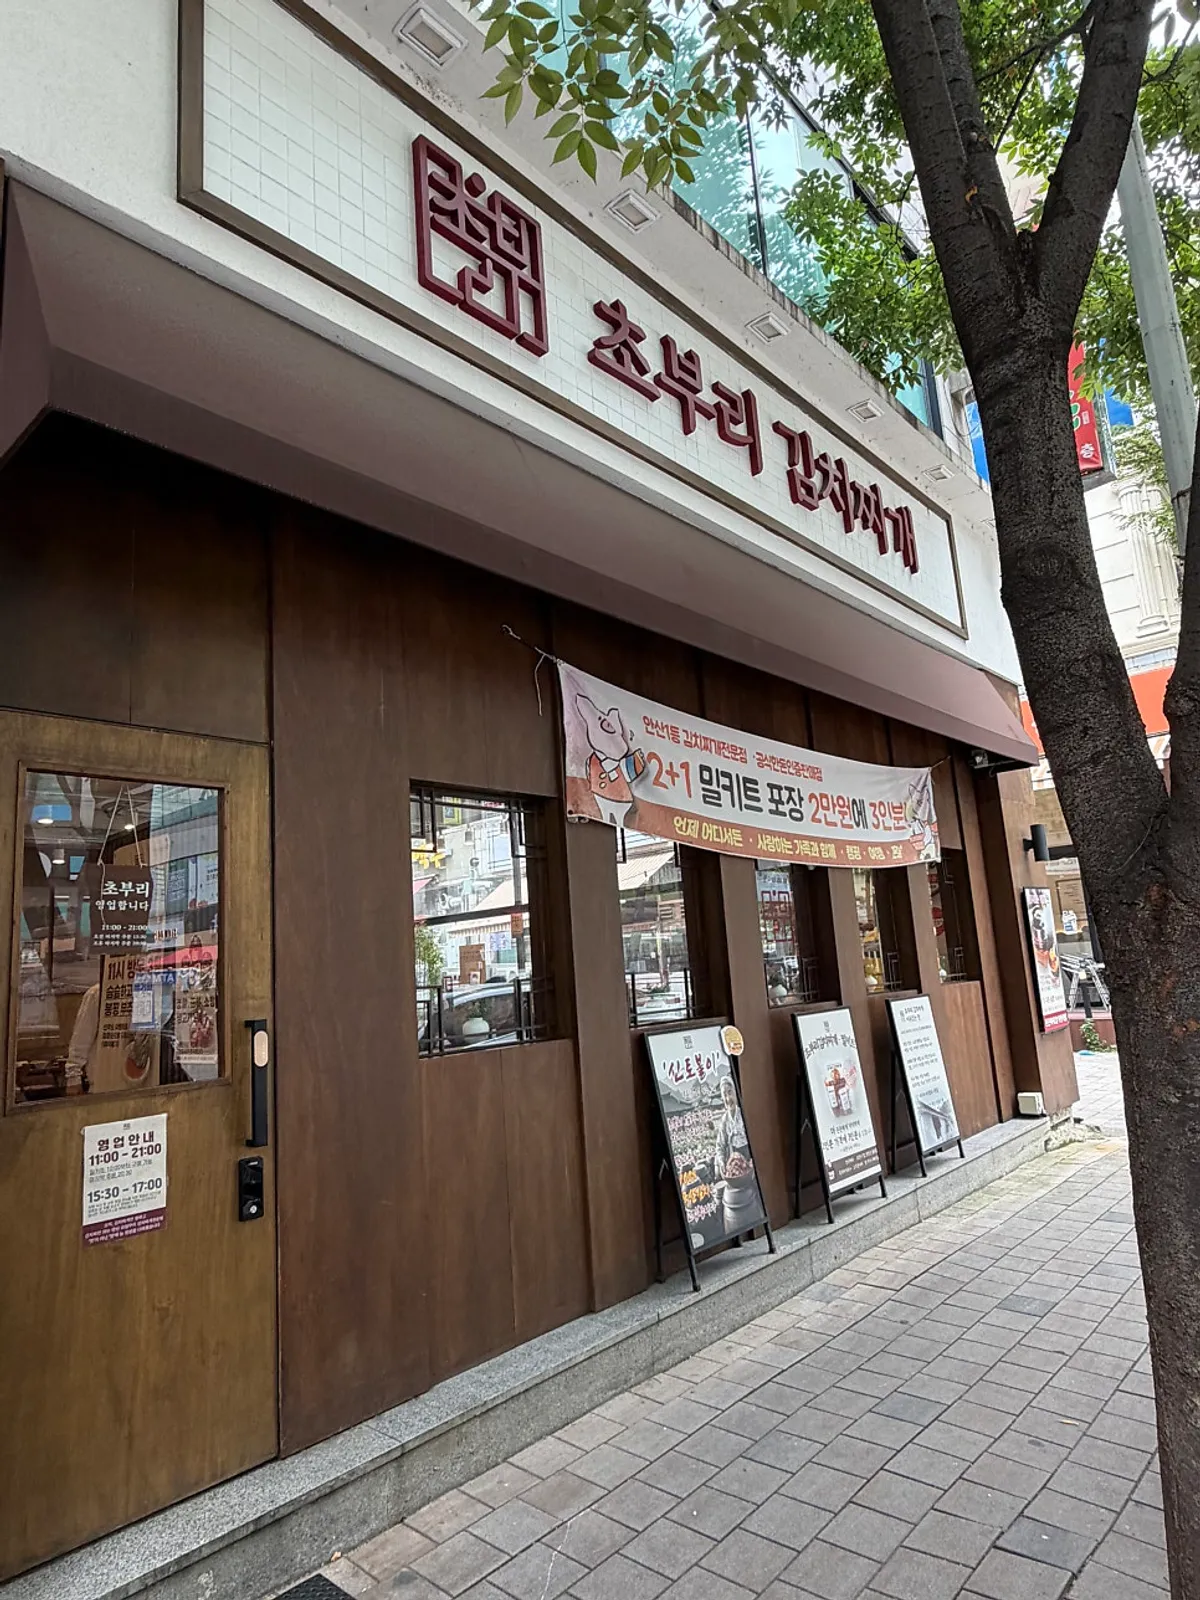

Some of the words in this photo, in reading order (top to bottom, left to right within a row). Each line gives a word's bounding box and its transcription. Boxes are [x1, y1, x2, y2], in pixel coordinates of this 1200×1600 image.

[587, 299, 762, 476] 초부리
[772, 420, 919, 574] 김치찌개
[642, 715, 681, 744] 안산1등
[682, 728, 748, 764] 김치찌개전문점
[646, 751, 693, 798] 2+1
[699, 764, 764, 816] 밀키트
[767, 783, 804, 822] 포장
[807, 794, 869, 830] 2만원에
[673, 816, 700, 838] 언제
[701, 822, 744, 847] 어디서든
[757, 833, 793, 855] 사랑하는
[794, 839, 820, 857] 가족과
[102, 880, 149, 898] 초부리
[95, 900, 149, 911] 영업합니다
[89, 1151, 119, 1166] 11:00
[131, 1143, 162, 1159] 21:00
[97, 1131, 155, 1152] 영업안내
[87, 1186, 120, 1203] 15:30
[132, 1177, 163, 1194] 17:00
